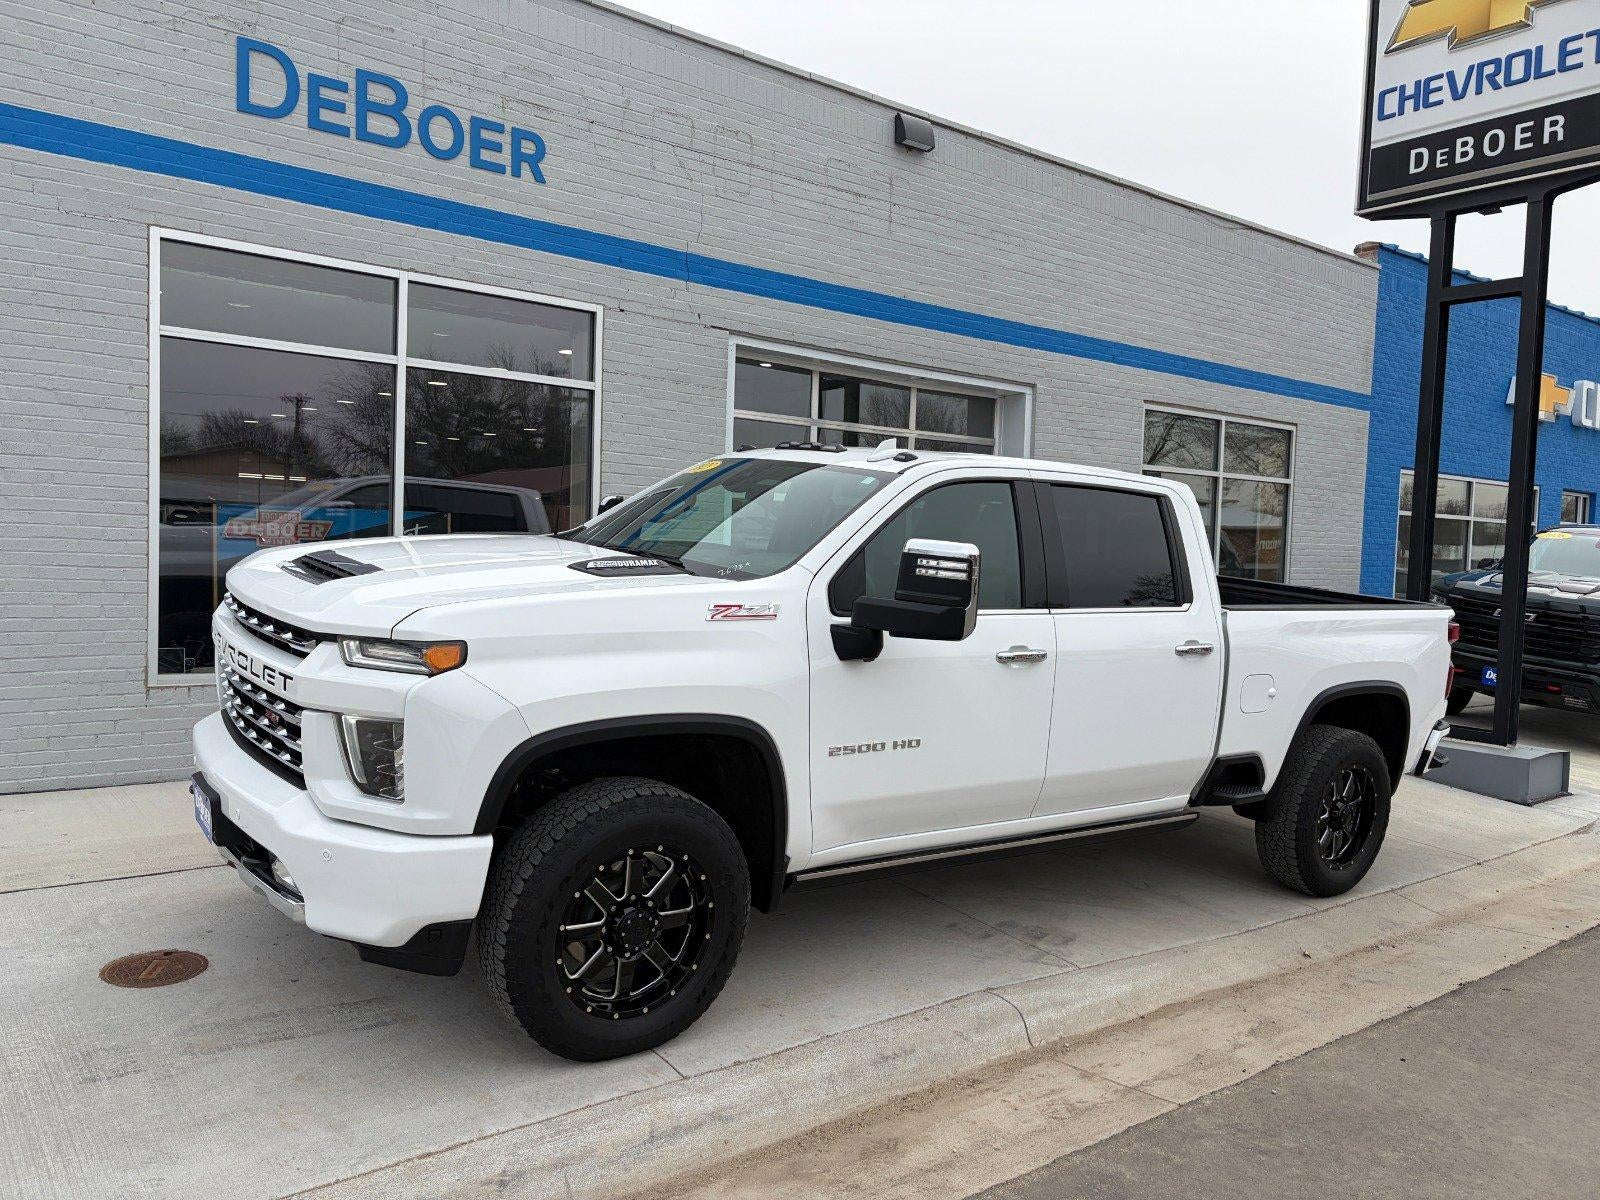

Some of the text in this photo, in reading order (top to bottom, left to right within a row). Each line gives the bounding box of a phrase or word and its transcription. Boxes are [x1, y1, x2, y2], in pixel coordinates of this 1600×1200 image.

[1377, 29, 1600, 121] CHEVROLET
[232, 520, 325, 538] DEBOER
[616, 559, 659, 567] DURAMAX
[705, 603, 780, 621] Z71
[828, 738, 921, 757] 2500 HD
